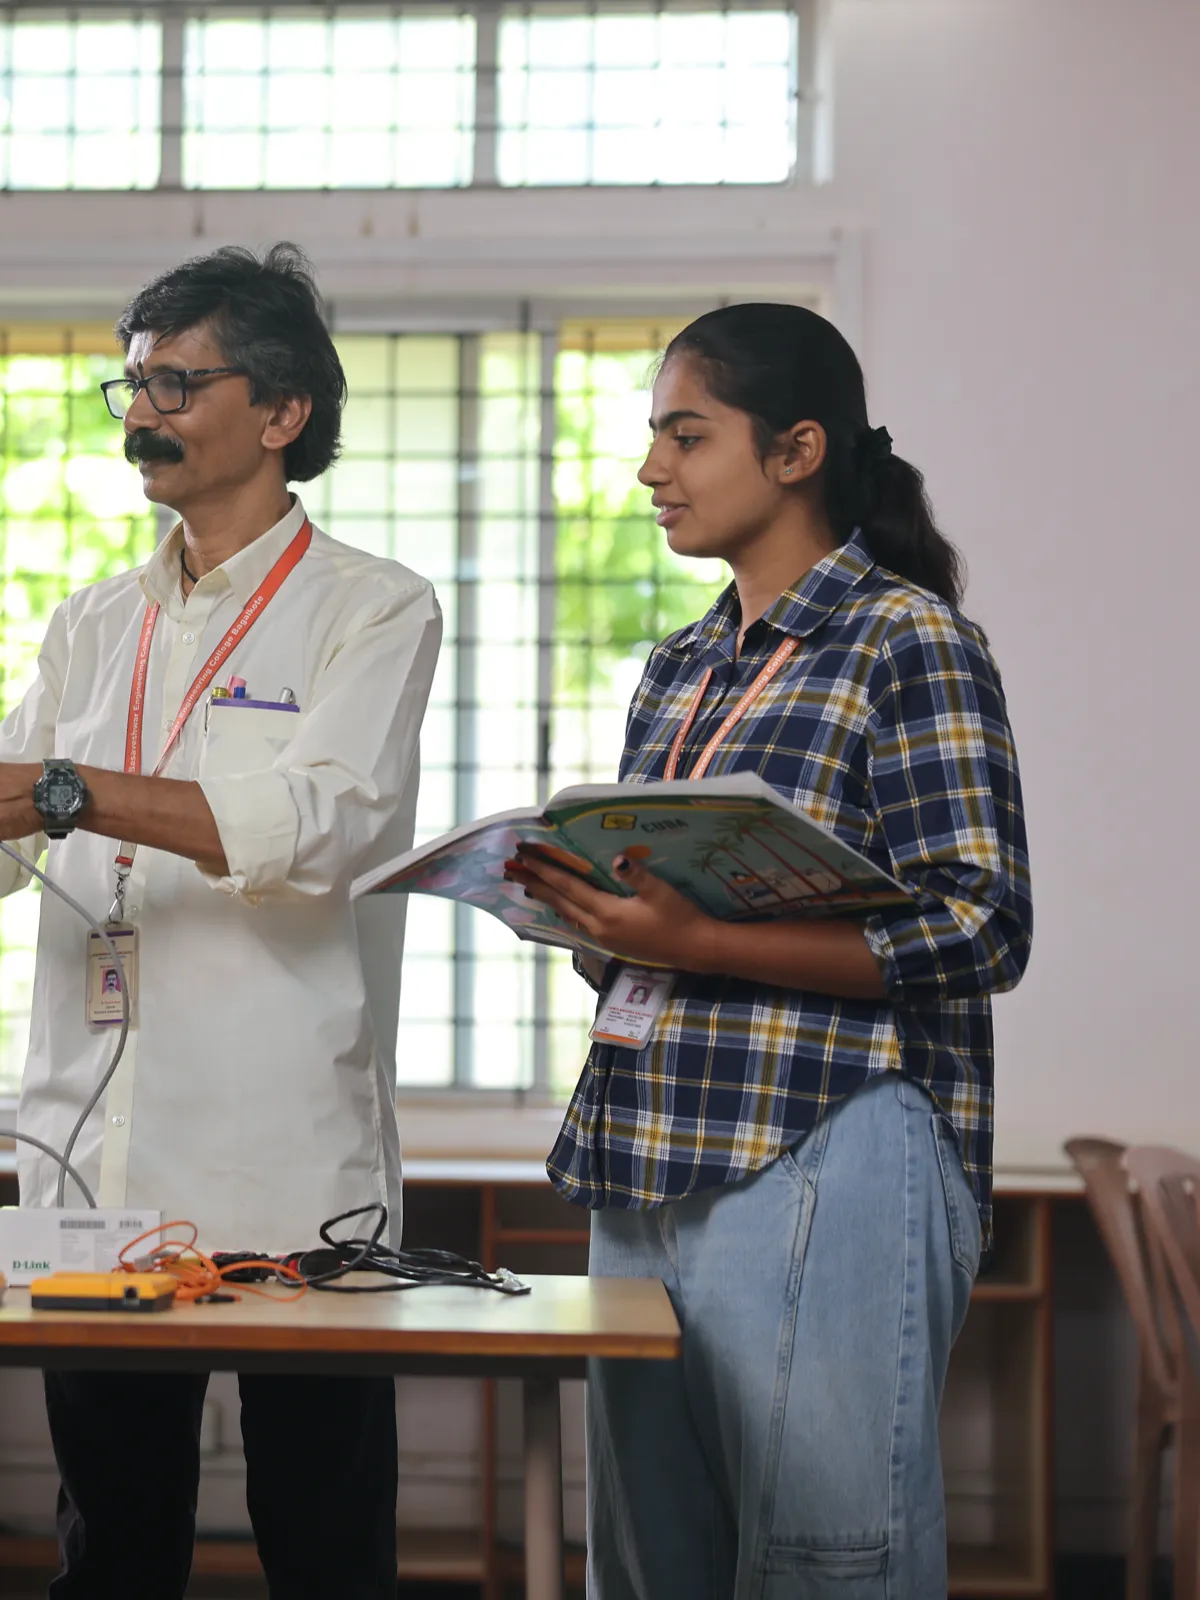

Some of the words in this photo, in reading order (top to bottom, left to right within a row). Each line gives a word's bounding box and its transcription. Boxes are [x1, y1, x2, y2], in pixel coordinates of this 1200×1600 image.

[209, 636, 234, 667] College
[231, 596, 264, 636] Bagalkote
[710, 675, 769, 727] Engineering
[128, 713, 139, 772] Basaveshwar
[641, 818, 689, 833] CUBA
[12, 1260, 50, 1270] D-Link
